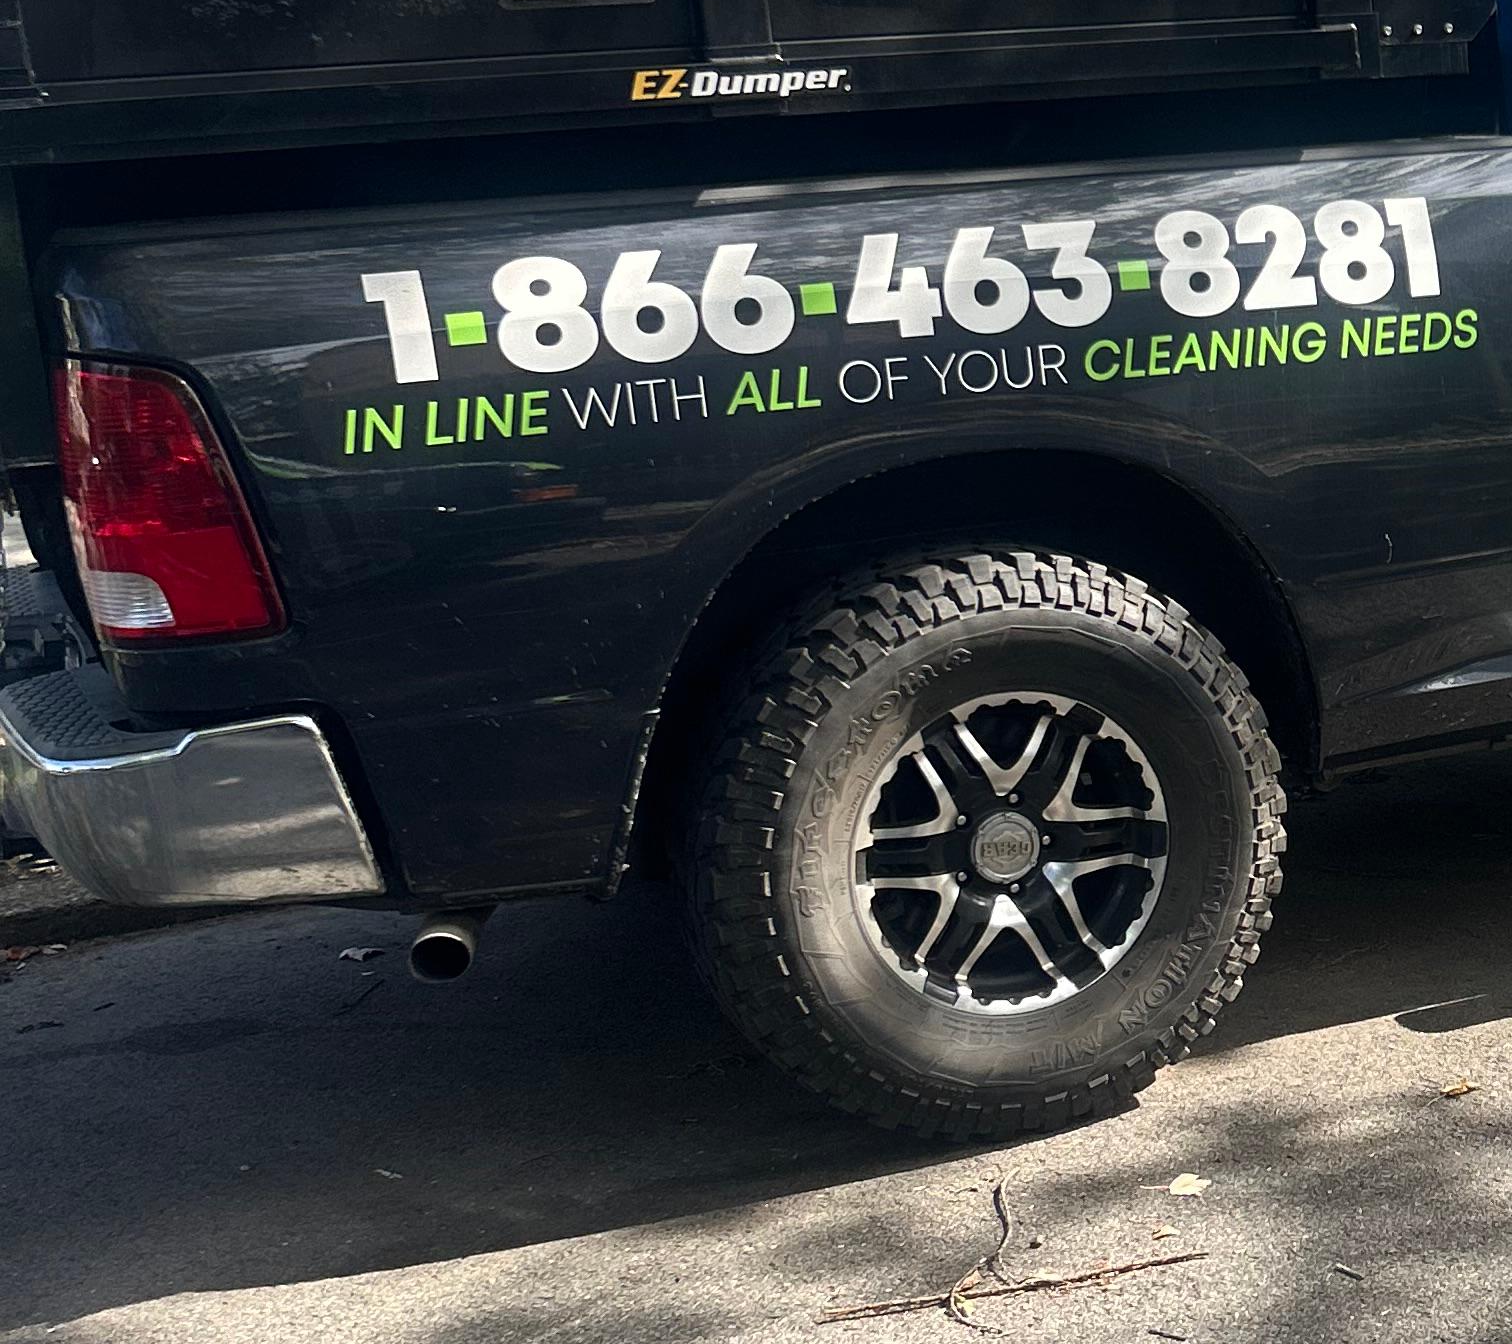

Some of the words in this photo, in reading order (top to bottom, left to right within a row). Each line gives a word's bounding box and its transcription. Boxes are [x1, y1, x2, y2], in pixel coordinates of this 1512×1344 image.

[360, 196, 1441, 385] 1-866-463-8281
[343, 403, 404, 455] IN
[424, 389, 551, 447] LINE
[560, 374, 709, 431] WITH
[726, 365, 823, 416] ALL
[837, 355, 909, 405] OF
[922, 343, 1069, 395] YOUR
[1083, 321, 1327, 382] CLEANING
[1338, 307, 1479, 359] NEEDS
